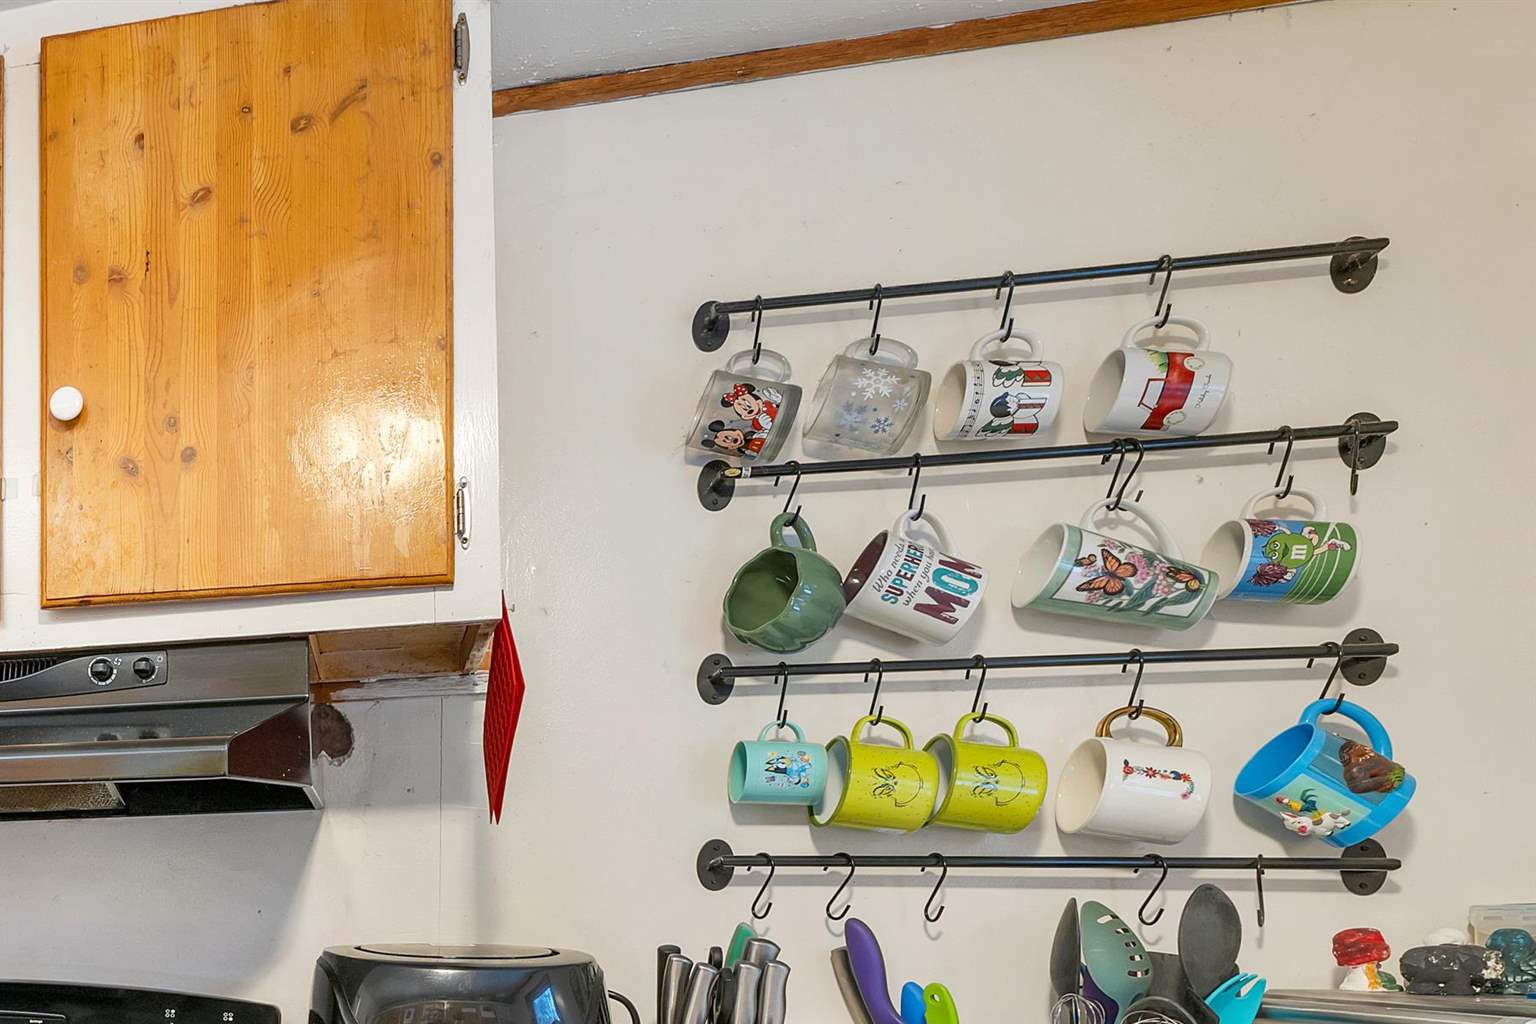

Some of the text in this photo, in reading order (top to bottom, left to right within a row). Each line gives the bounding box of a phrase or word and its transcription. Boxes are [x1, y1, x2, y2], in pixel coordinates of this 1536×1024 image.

[872, 570, 893, 593] Who
[881, 541, 925, 605] SUPERHER
[902, 561, 933, 606] when you
